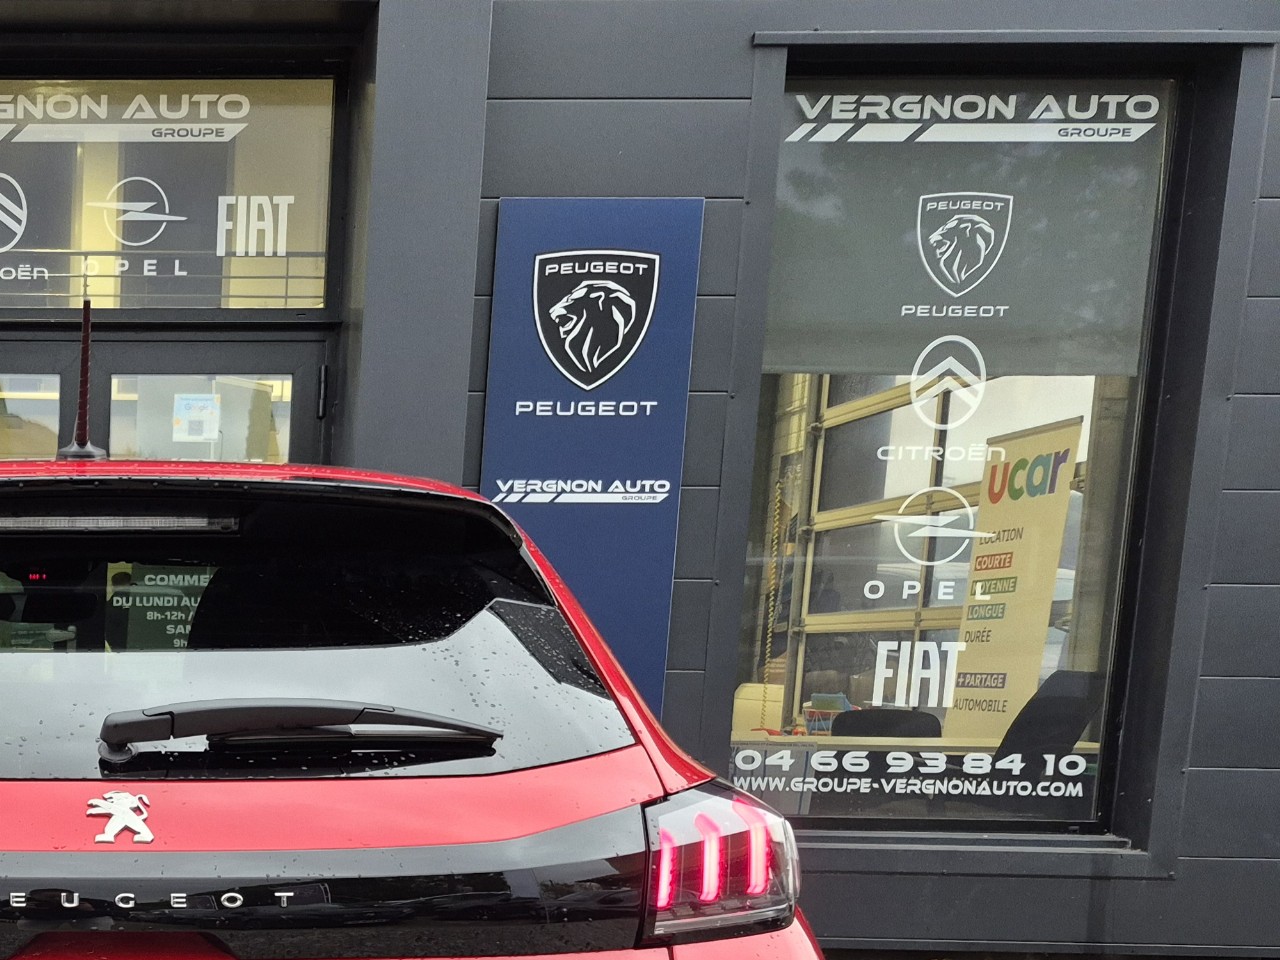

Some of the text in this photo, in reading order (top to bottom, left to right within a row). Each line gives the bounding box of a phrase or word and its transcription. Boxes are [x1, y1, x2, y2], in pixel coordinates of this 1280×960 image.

[121, 94, 251, 120] AUTO
[795, 94, 1161, 120] VERGNON AUTO
[151, 127, 226, 139] GROUPE
[1057, 127, 1133, 138] GROUPE
[925, 200, 1005, 212] PEUGEOT
[216, 195, 295, 257] FIAT
[82, 258, 188, 277] OPEL
[545, 261, 649, 276] PEUGEOT
[900, 304, 1010, 318] PEUGEOT
[515, 400, 658, 416] PEUGEOT
[988, 447, 1071, 504] ucar
[495, 479, 671, 493] VERGNON AUTO
[978, 526, 1024, 546] LOCATION
[975, 555, 1012, 570] COURTE
[144, 574, 214, 587] COMME
[863, 580, 992, 600] OPEL
[112, 596, 132, 607] DU
[135, 596, 178, 607] LUNDI
[146, 611, 185, 621] 8h-12h
[968, 604, 1005, 619] LONGUE
[964, 627, 992, 643] DURÉE
[871, 640, 967, 708] FIAT
[953, 698, 1008, 713] AUTOMOBILE
[734, 749, 1087, 777] 04 66 93 84 10
[732, 776, 1084, 798] WWW.GROUPE-VERGNONAUTO.COM
